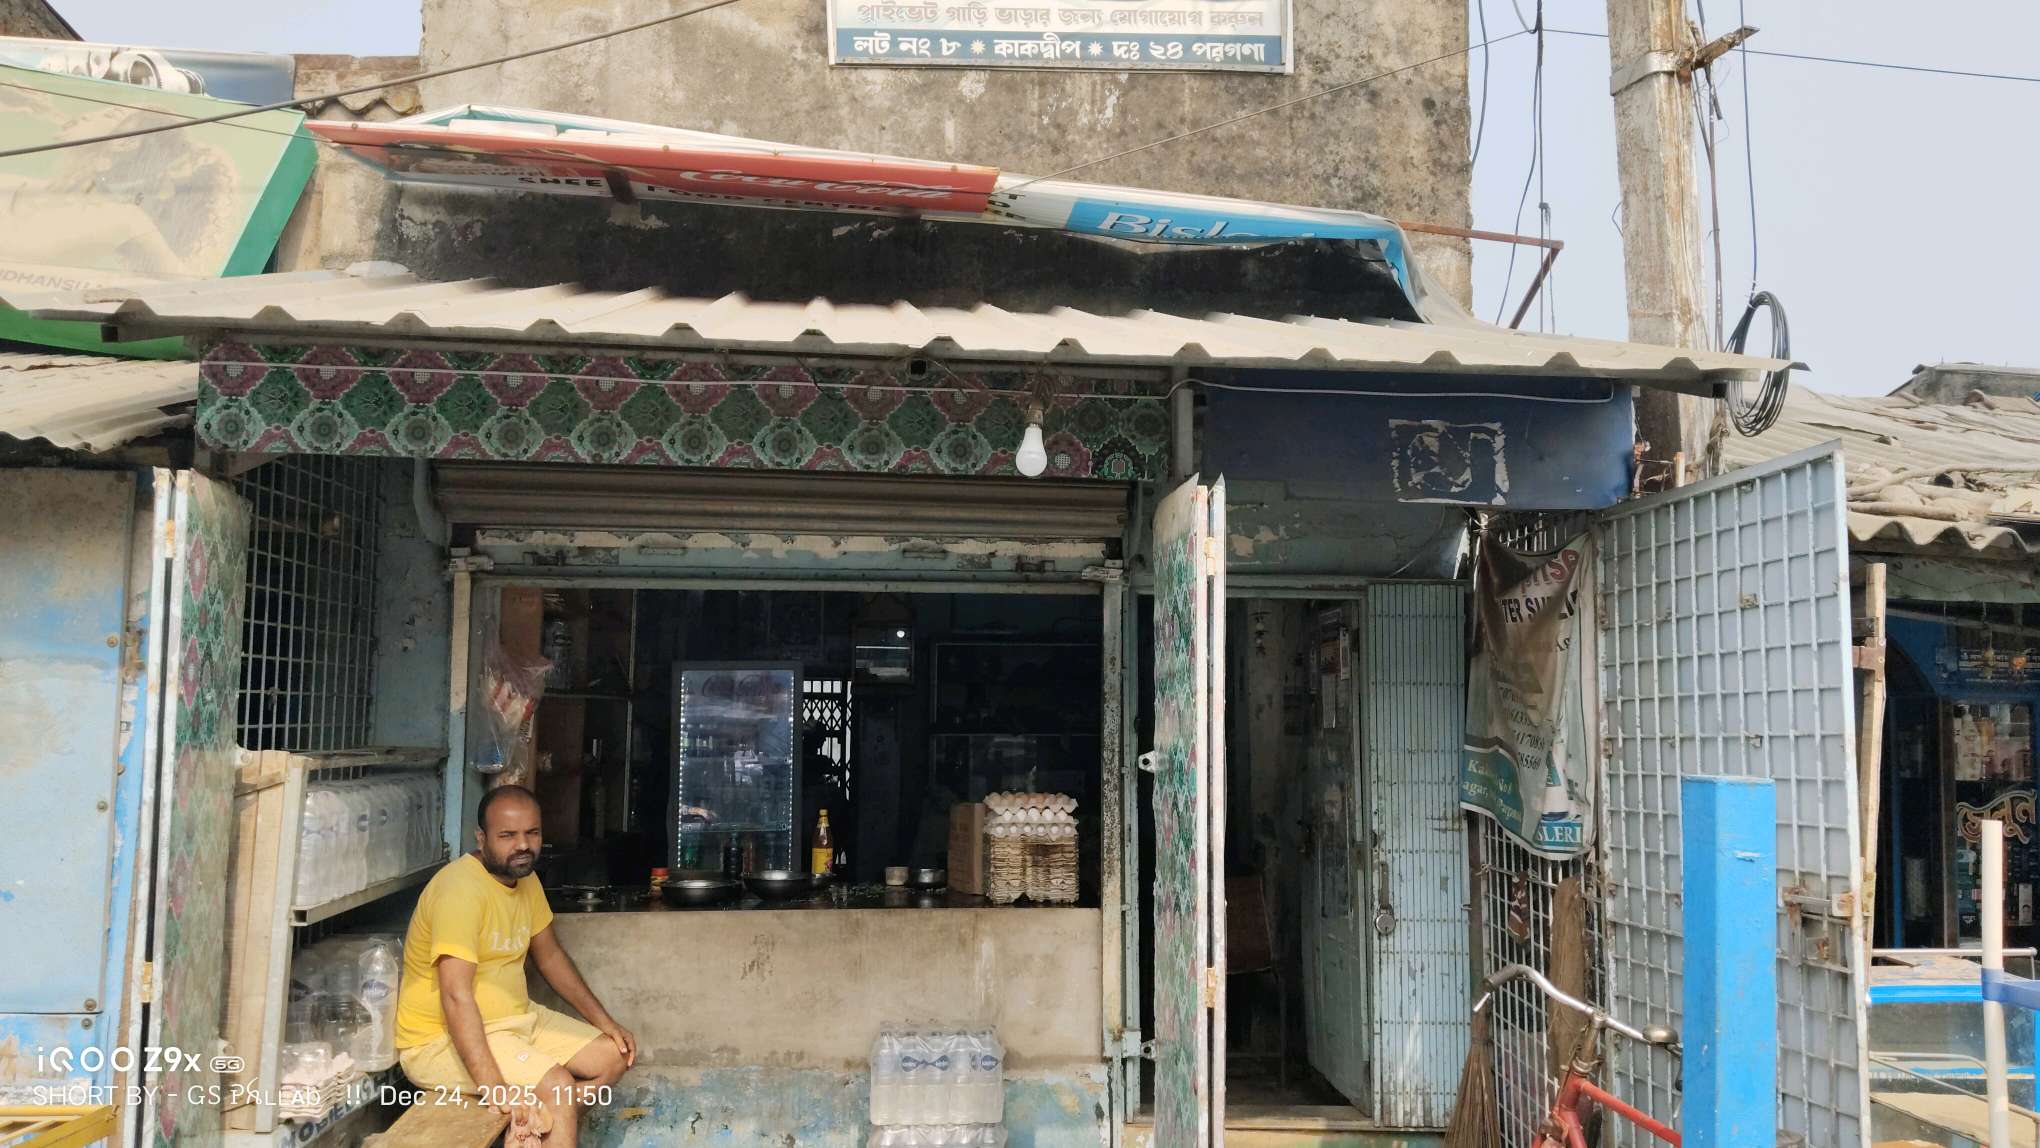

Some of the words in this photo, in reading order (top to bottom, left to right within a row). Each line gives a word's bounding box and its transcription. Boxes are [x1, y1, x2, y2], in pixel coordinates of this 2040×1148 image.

[857, 3, 939, 24] প্রাইভেট
[946, 4, 987, 26] গাড়ি
[994, 7, 1050, 27] ভাড়ার
[1058, 8, 1104, 26] জন্য
[1109, 9, 1204, 27] যোগাযোগ
[853, 31, 891, 55] লট
[897, 38, 931, 57] নং
[939, 38, 962, 56] ৮
[993, 32, 1081, 59] কাকদ্বীপ
[1111, 40, 1141, 60] দঃ
[1149, 41, 1184, 60] ২৪
